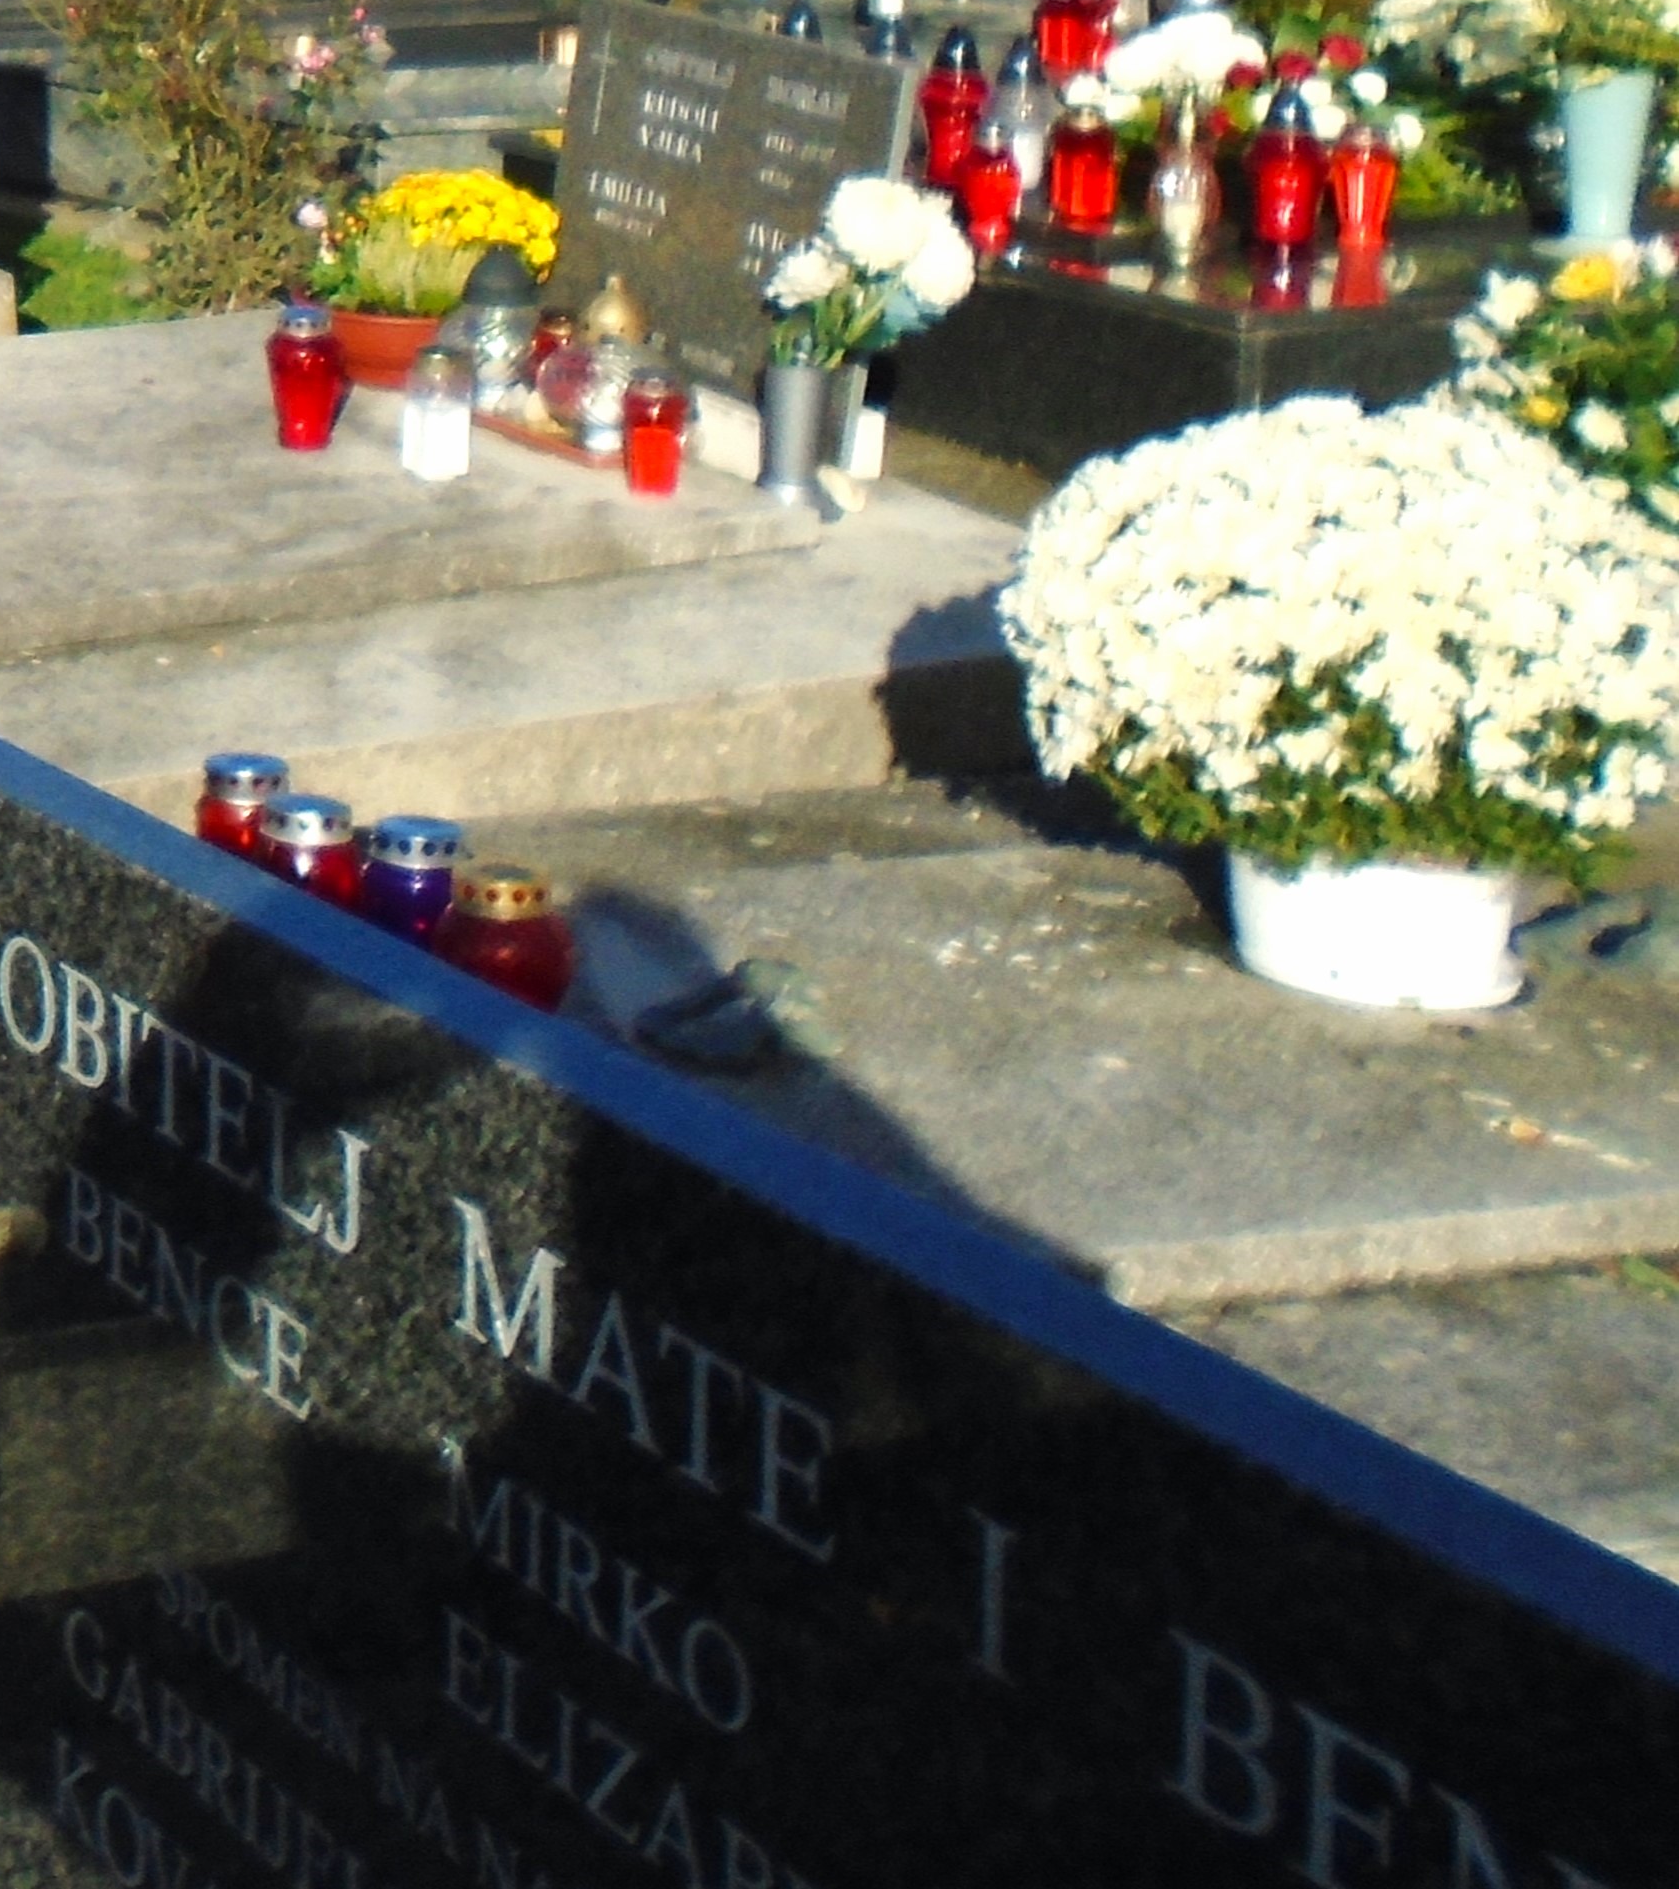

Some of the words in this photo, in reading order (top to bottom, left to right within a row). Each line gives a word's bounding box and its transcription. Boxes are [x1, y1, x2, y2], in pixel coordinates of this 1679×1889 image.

[65, 1162, 314, 1422] BENCE
[439, 1436, 753, 1734] MIRKO
[450, 1195, 837, 1566] MATE
[968, 1506, 1020, 1691] I
